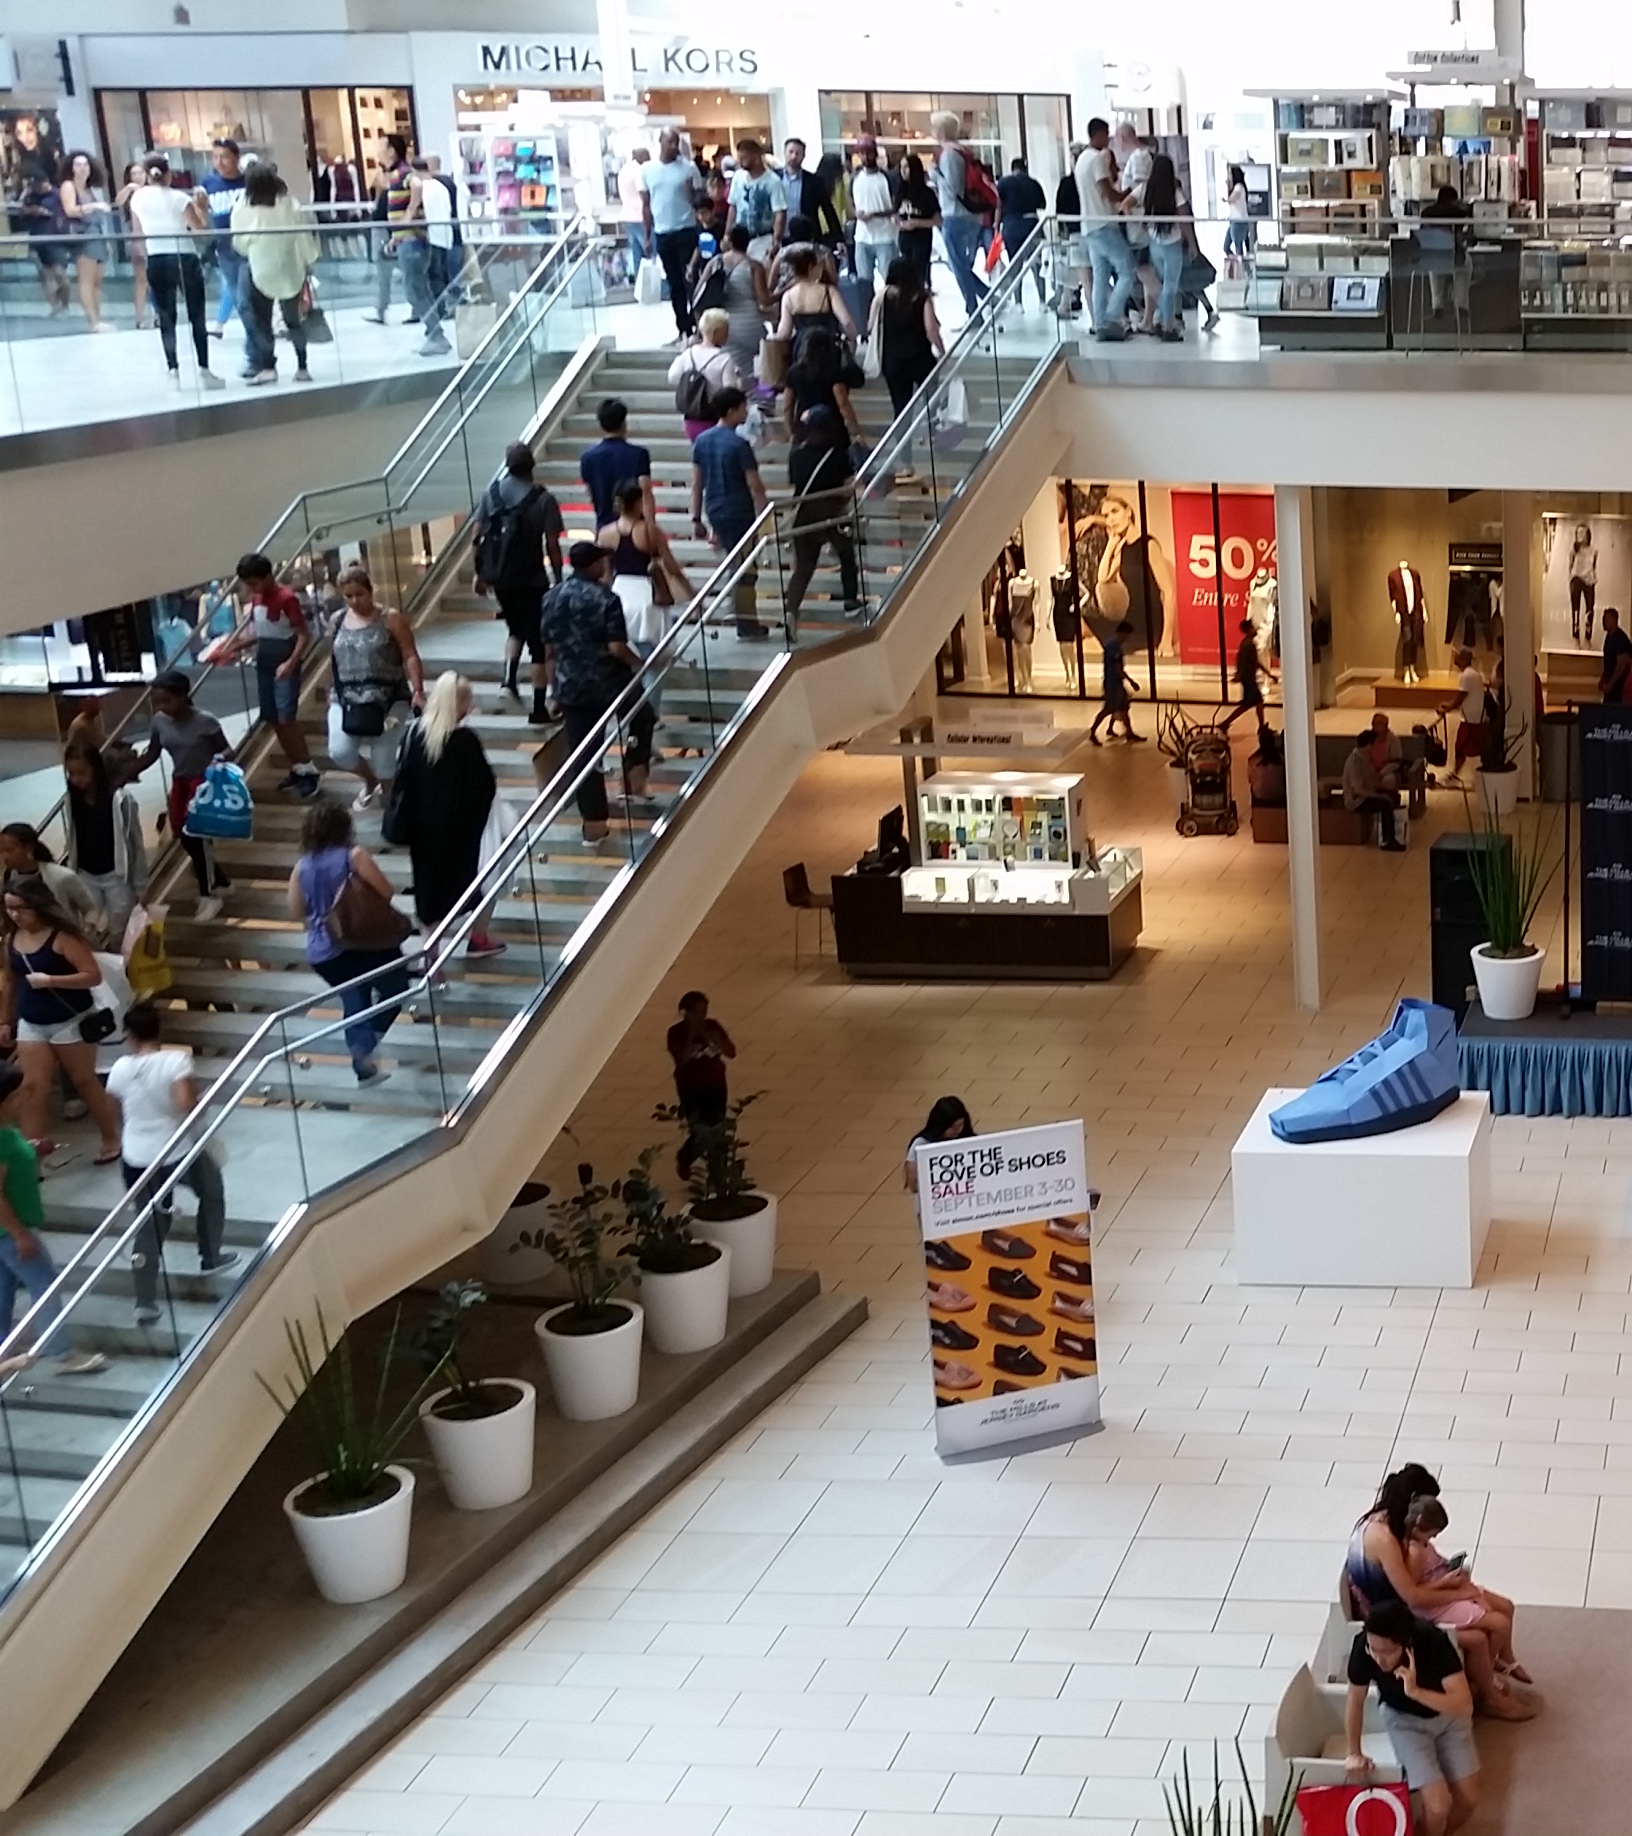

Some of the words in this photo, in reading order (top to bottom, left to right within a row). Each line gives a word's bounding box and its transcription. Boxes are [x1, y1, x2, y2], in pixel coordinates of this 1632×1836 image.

[480, 44, 648, 73] MICHAL
[663, 47, 758, 75] KORS
[1192, 587, 1239, 608] Entre
[928, 1151, 965, 1172] FOR
[967, 1146, 1003, 1164] THE
[930, 1165, 977, 1186] LOVE
[979, 1160, 1005, 1178] OF
[1007, 1149, 1067, 1174] SHOES
[930, 1180, 975, 1201] SALE
[932, 1186, 1034, 1215] SEPTEMBER
[1037, 1176, 1076, 1196] 3-30
